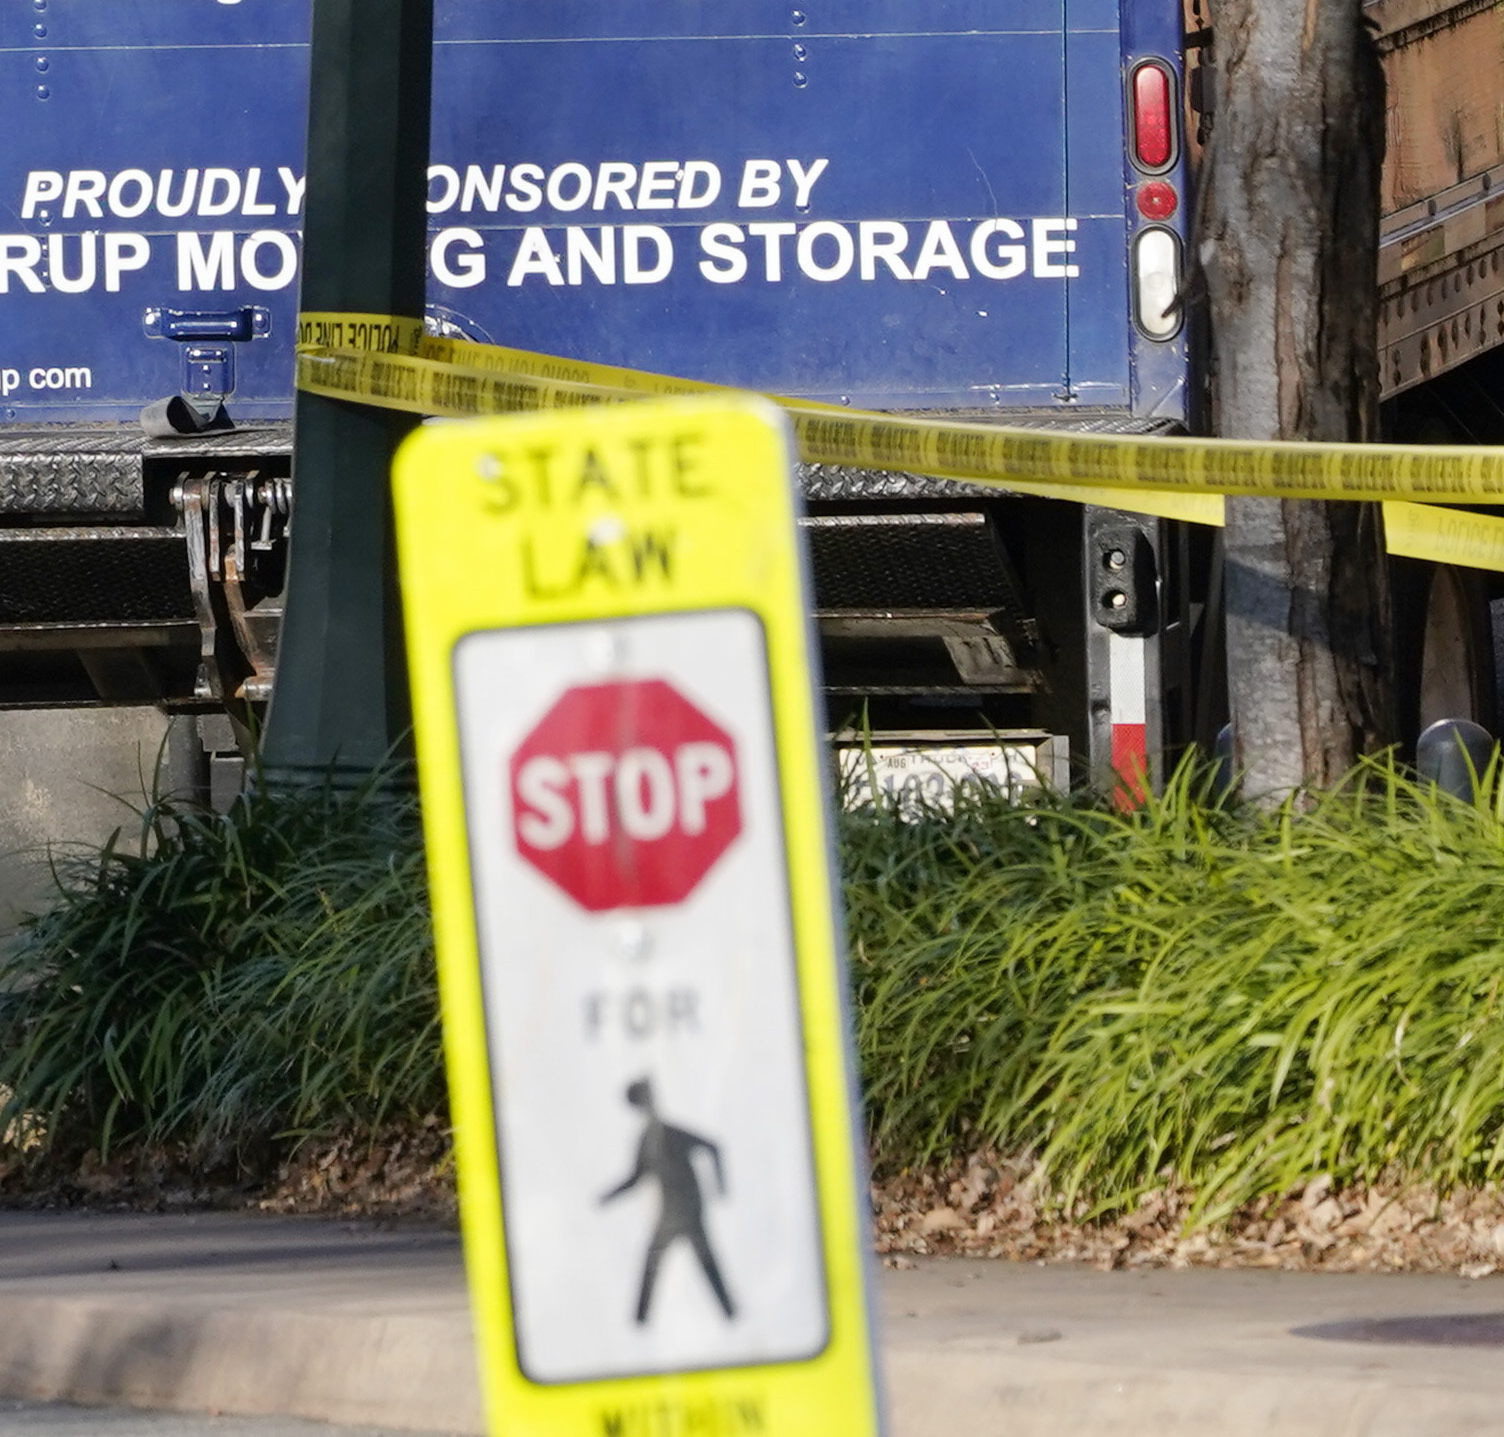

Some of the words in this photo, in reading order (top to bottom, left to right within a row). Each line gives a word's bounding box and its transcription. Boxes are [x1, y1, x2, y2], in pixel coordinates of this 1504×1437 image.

[21, 166, 307, 219] PROUDLY
[425, 160, 721, 214] ONSORED
[739, 158, 830, 210] BY
[508, 224, 674, 286] AND
[698, 219, 1080, 282] STORAGE
[482, 434, 718, 516] STATE
[521, 525, 676, 602] LAW
[514, 741, 734, 850] STOP
[584, 989, 702, 1041] FOR
